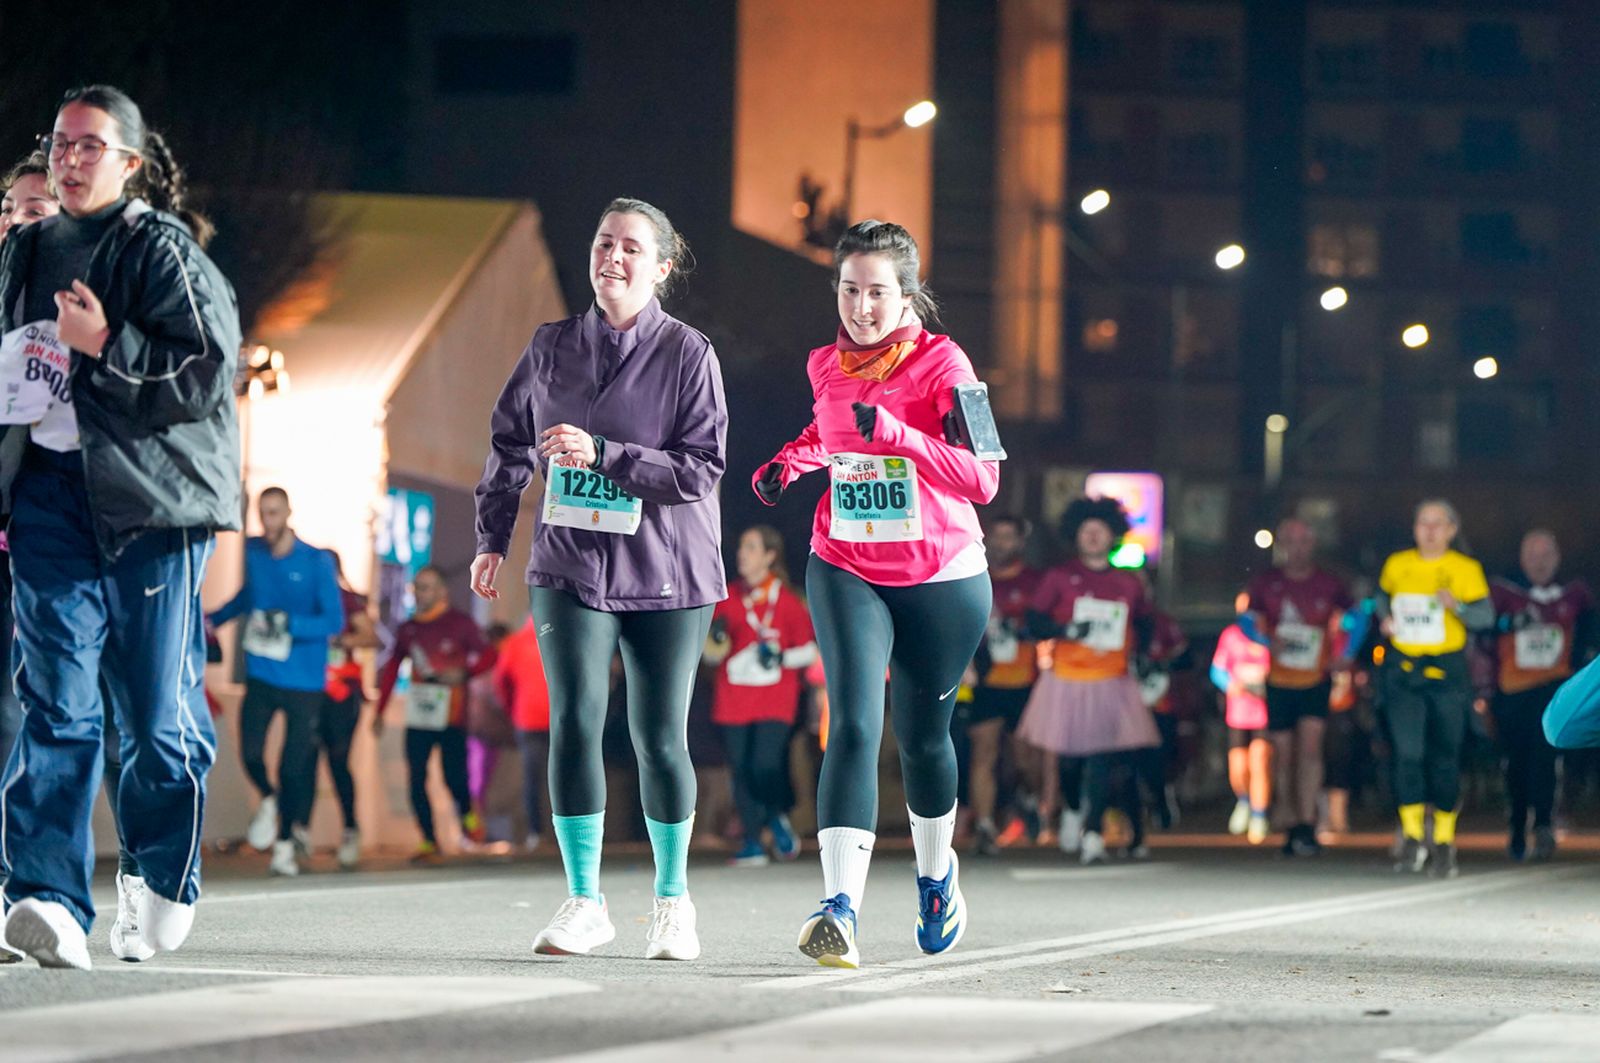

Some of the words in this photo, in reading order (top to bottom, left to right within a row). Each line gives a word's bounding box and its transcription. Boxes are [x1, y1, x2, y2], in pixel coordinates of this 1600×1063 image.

[863, 462, 875, 471] DE
[836, 481, 907, 511] 13306
[585, 500, 608, 510] Cristina
